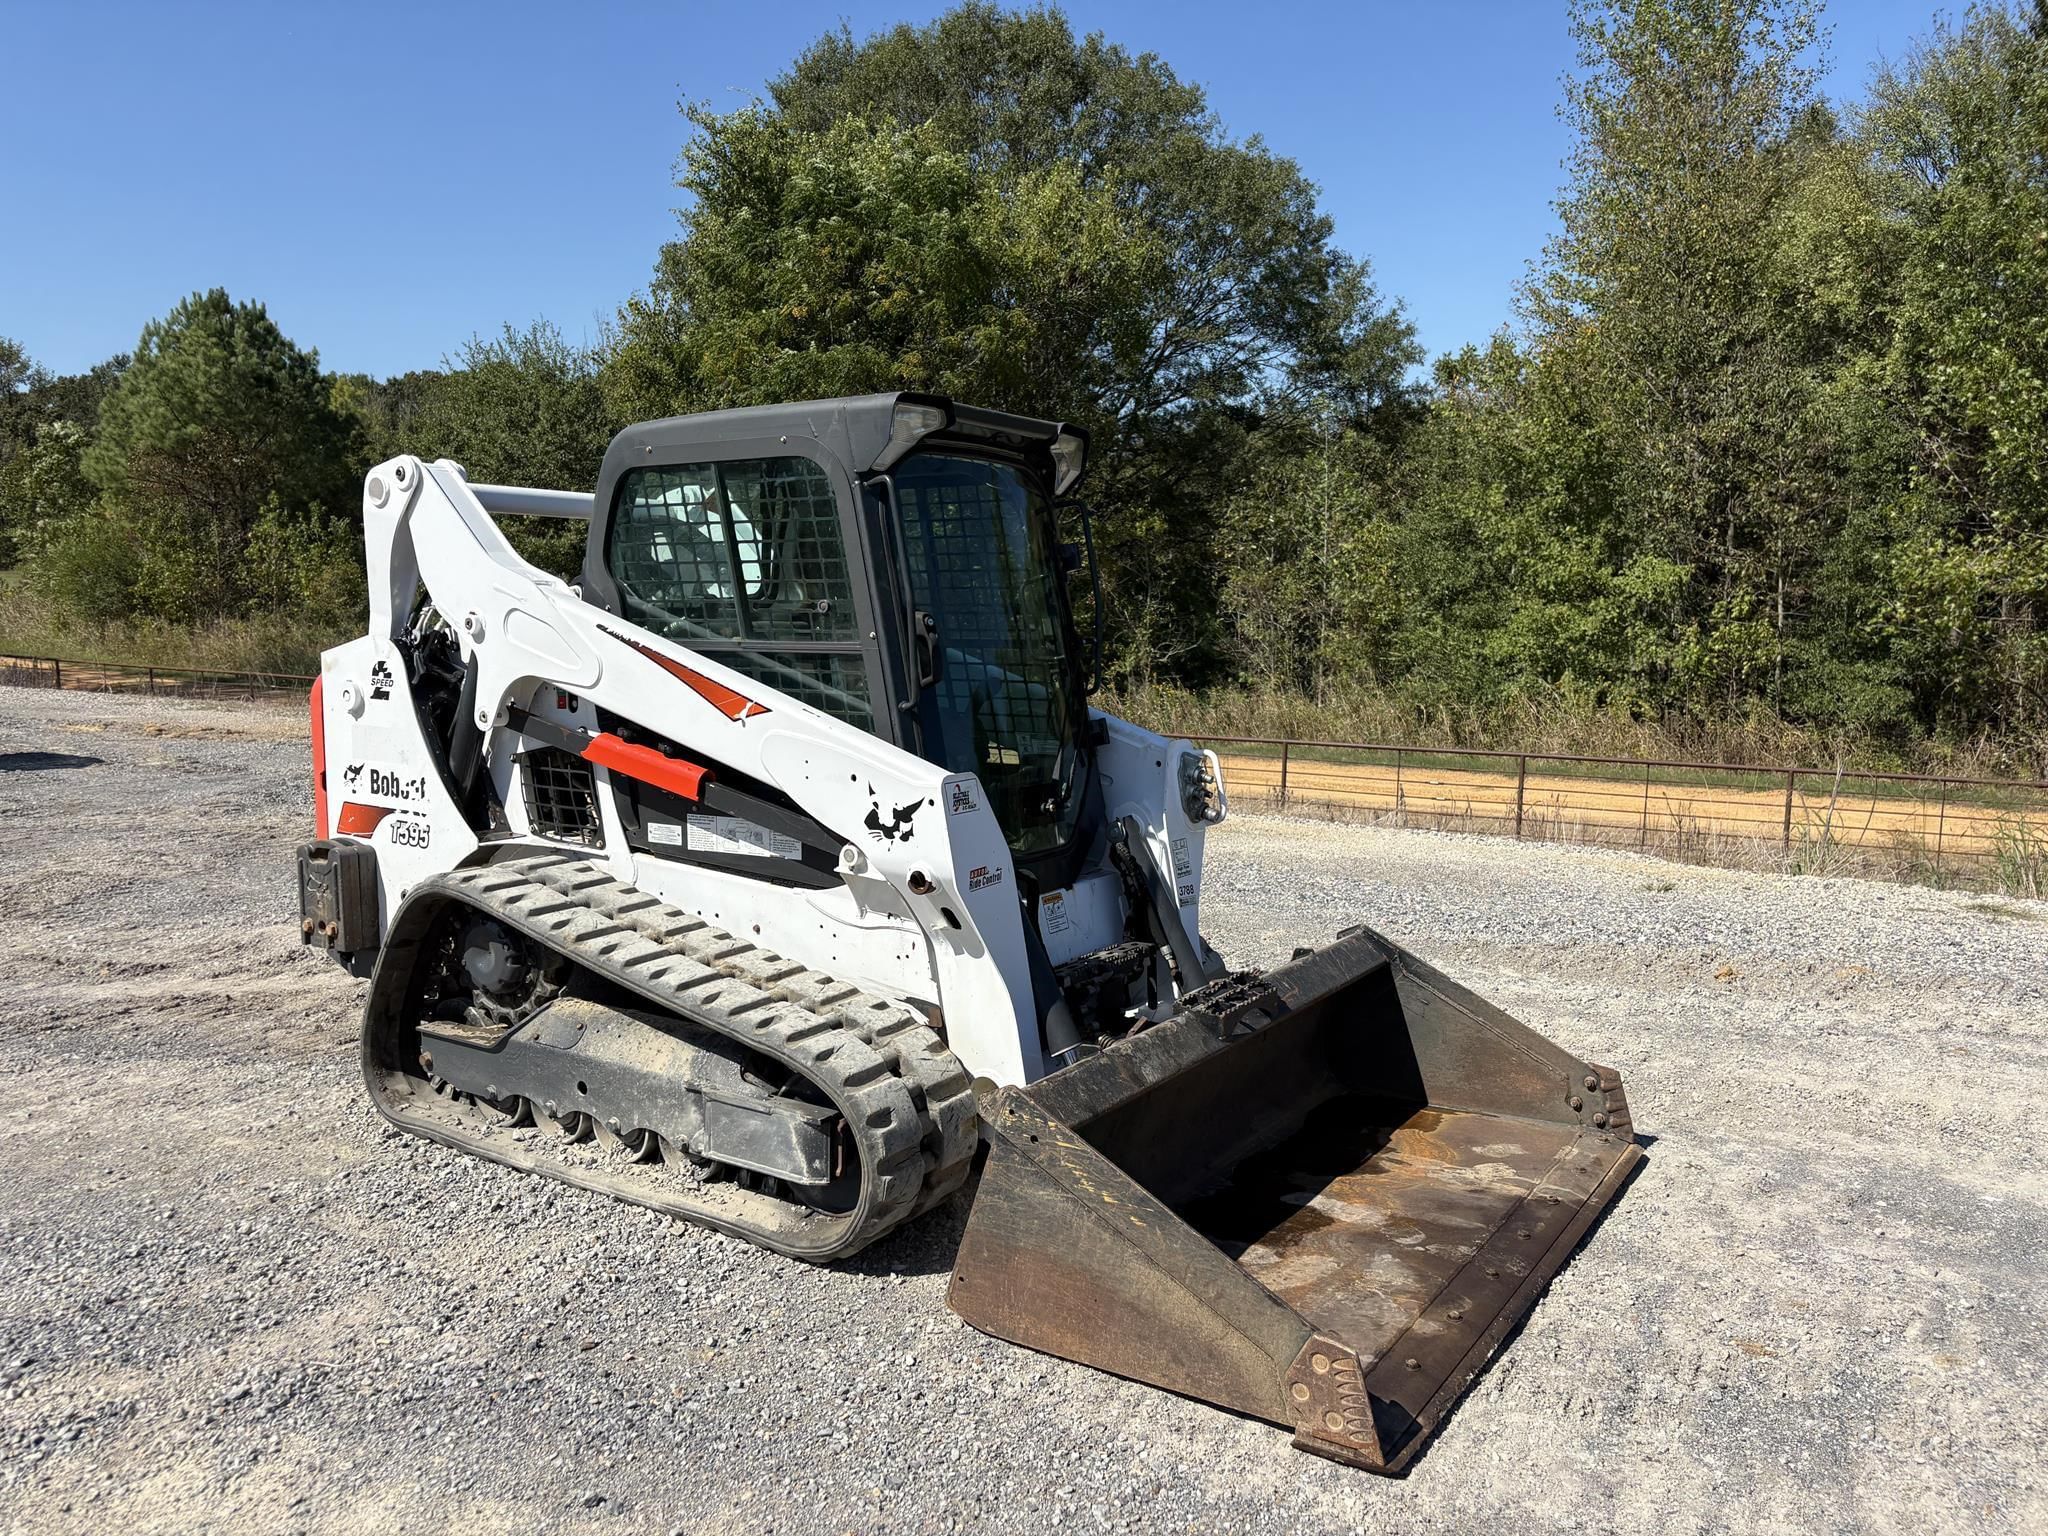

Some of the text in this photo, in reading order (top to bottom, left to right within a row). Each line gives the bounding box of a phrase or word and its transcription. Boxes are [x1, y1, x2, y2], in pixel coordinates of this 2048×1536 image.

[370, 677, 395, 688] SPEED
[390, 819, 431, 850] T595
[983, 871, 1002, 886] Control
[1179, 884, 1194, 896] 3788
